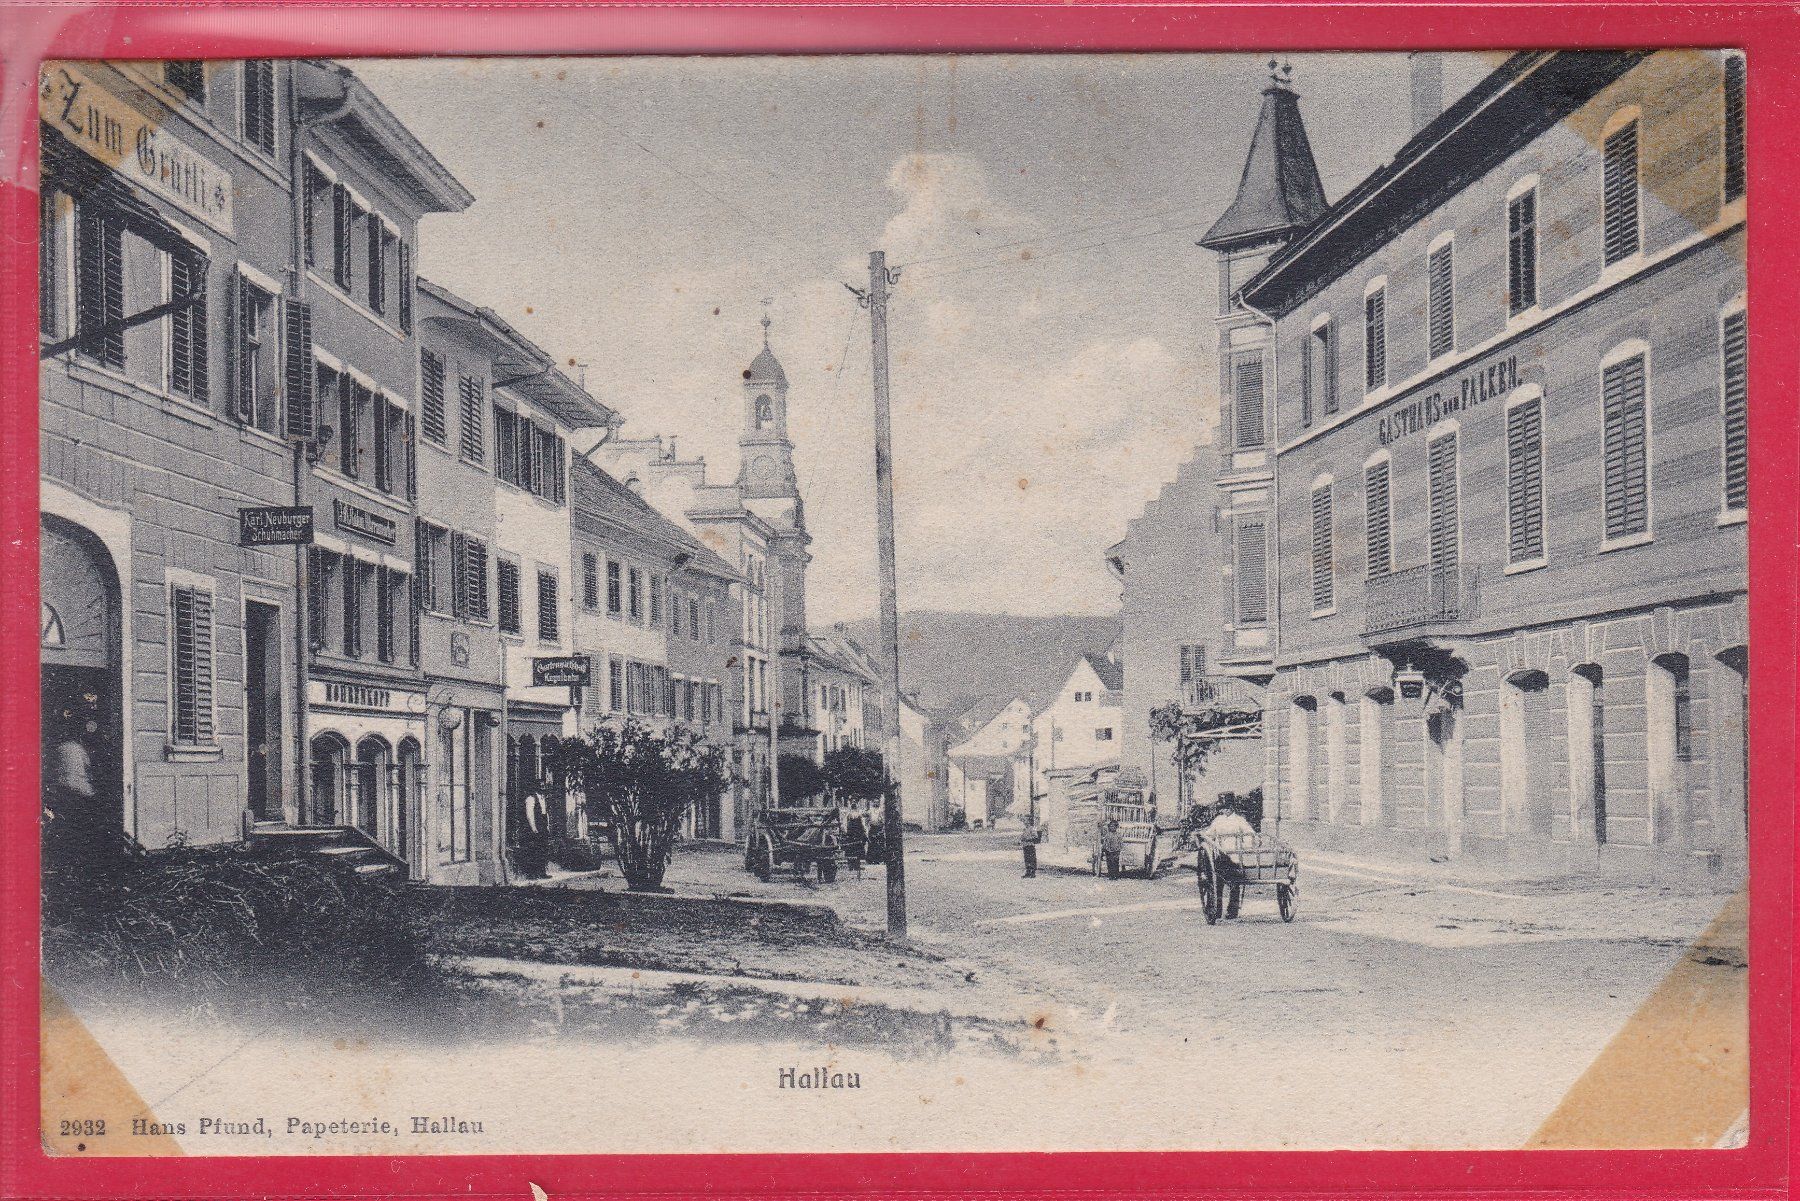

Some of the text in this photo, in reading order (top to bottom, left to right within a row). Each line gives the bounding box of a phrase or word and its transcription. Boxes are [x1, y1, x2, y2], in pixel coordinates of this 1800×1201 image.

[60, 68, 122, 155] Zum
[1378, 392, 1442, 446] GASTHAUS
[244, 510, 310, 528] Karl Neuburger
